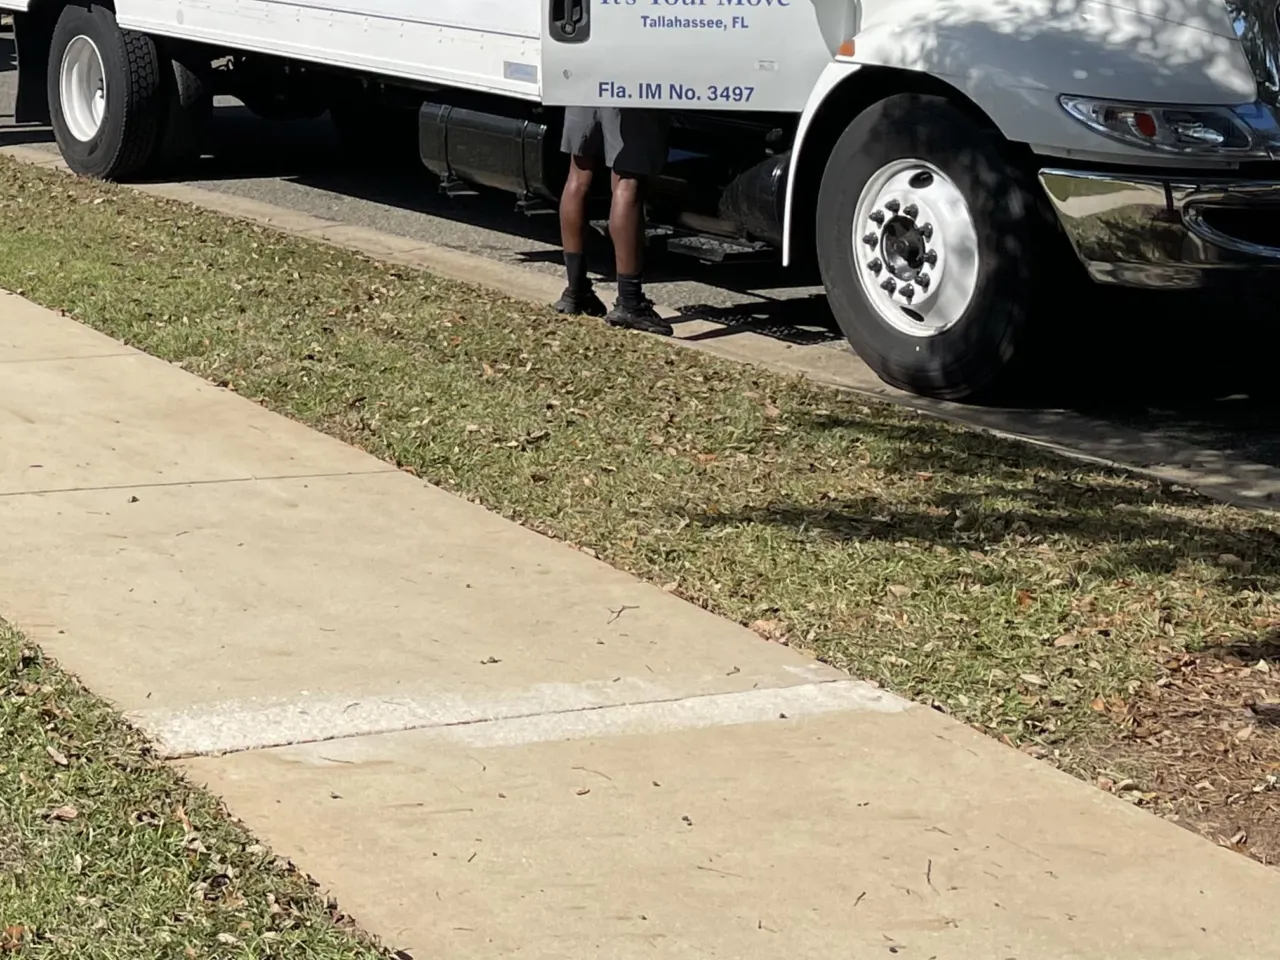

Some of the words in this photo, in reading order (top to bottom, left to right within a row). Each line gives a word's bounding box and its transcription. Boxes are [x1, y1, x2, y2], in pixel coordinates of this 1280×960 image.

[640, 15, 728, 31] Tallahassee,
[732, 16, 749, 29] FL
[598, 81, 633, 99] Fla.
[638, 82, 662, 100] IM
[669, 83, 701, 101] No.
[707, 85, 755, 103] 3497
